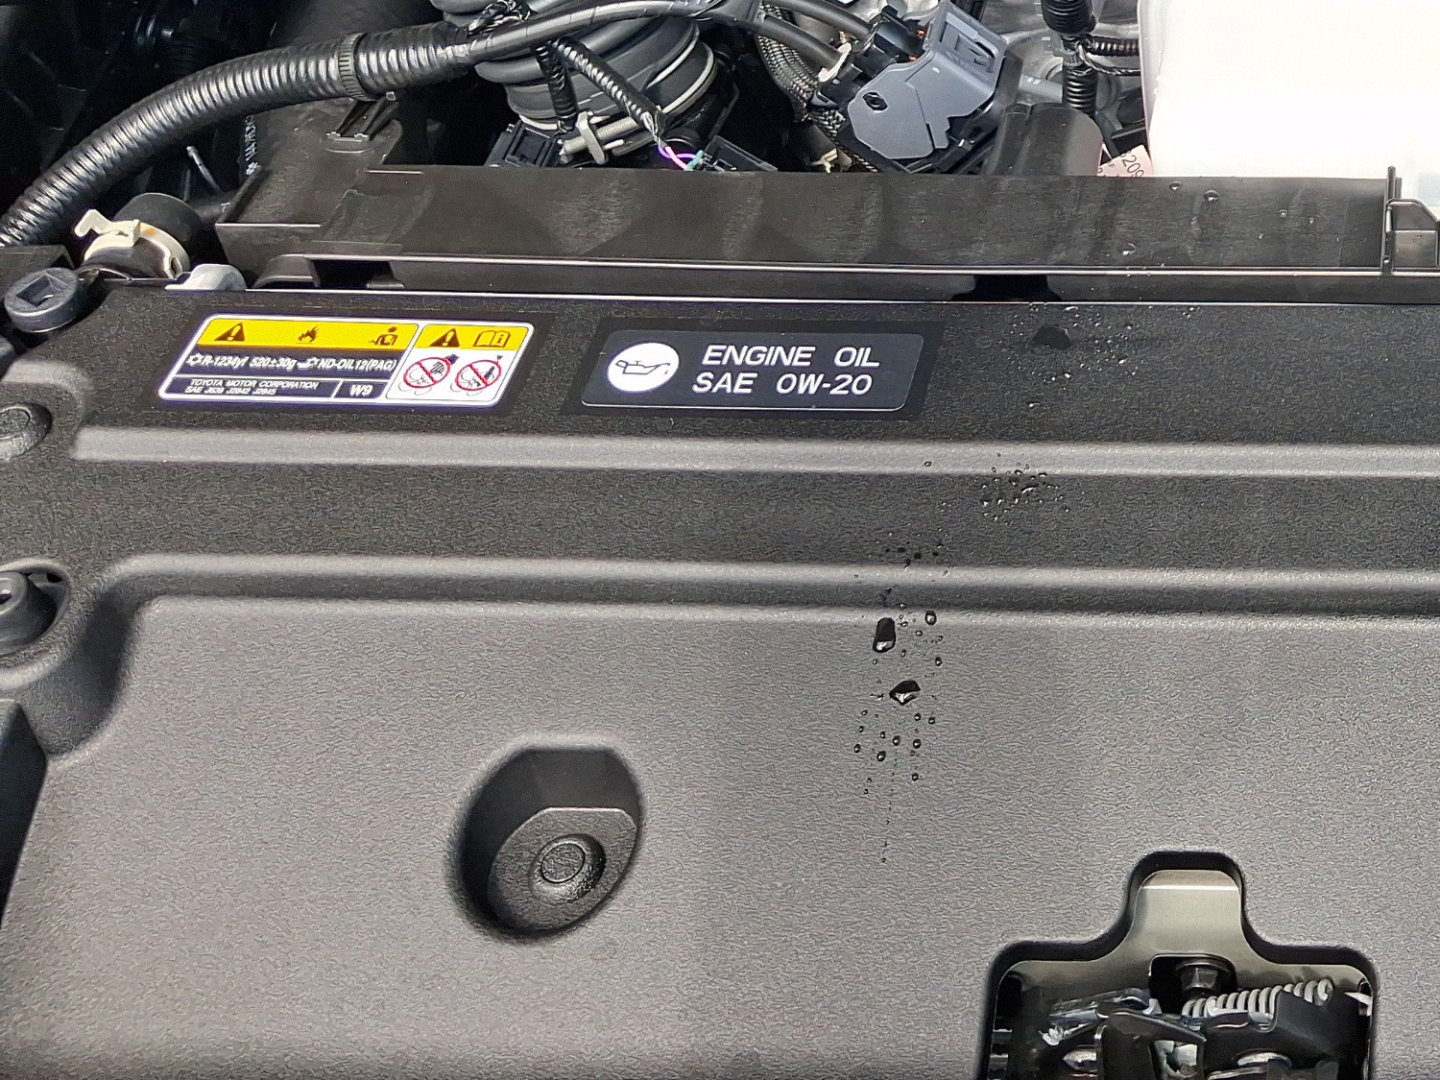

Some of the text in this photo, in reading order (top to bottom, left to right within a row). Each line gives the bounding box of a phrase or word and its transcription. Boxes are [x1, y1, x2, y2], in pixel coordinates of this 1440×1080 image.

[201, 355, 249, 370] R-1234yf
[701, 344, 880, 368] ENGINE OIL
[184, 386, 202, 394] SAE
[190, 378, 319, 390] TOYOTA MOTOR CORPORATION
[349, 384, 374, 396] W9
[692, 372, 873, 396] SAE 0W-20
